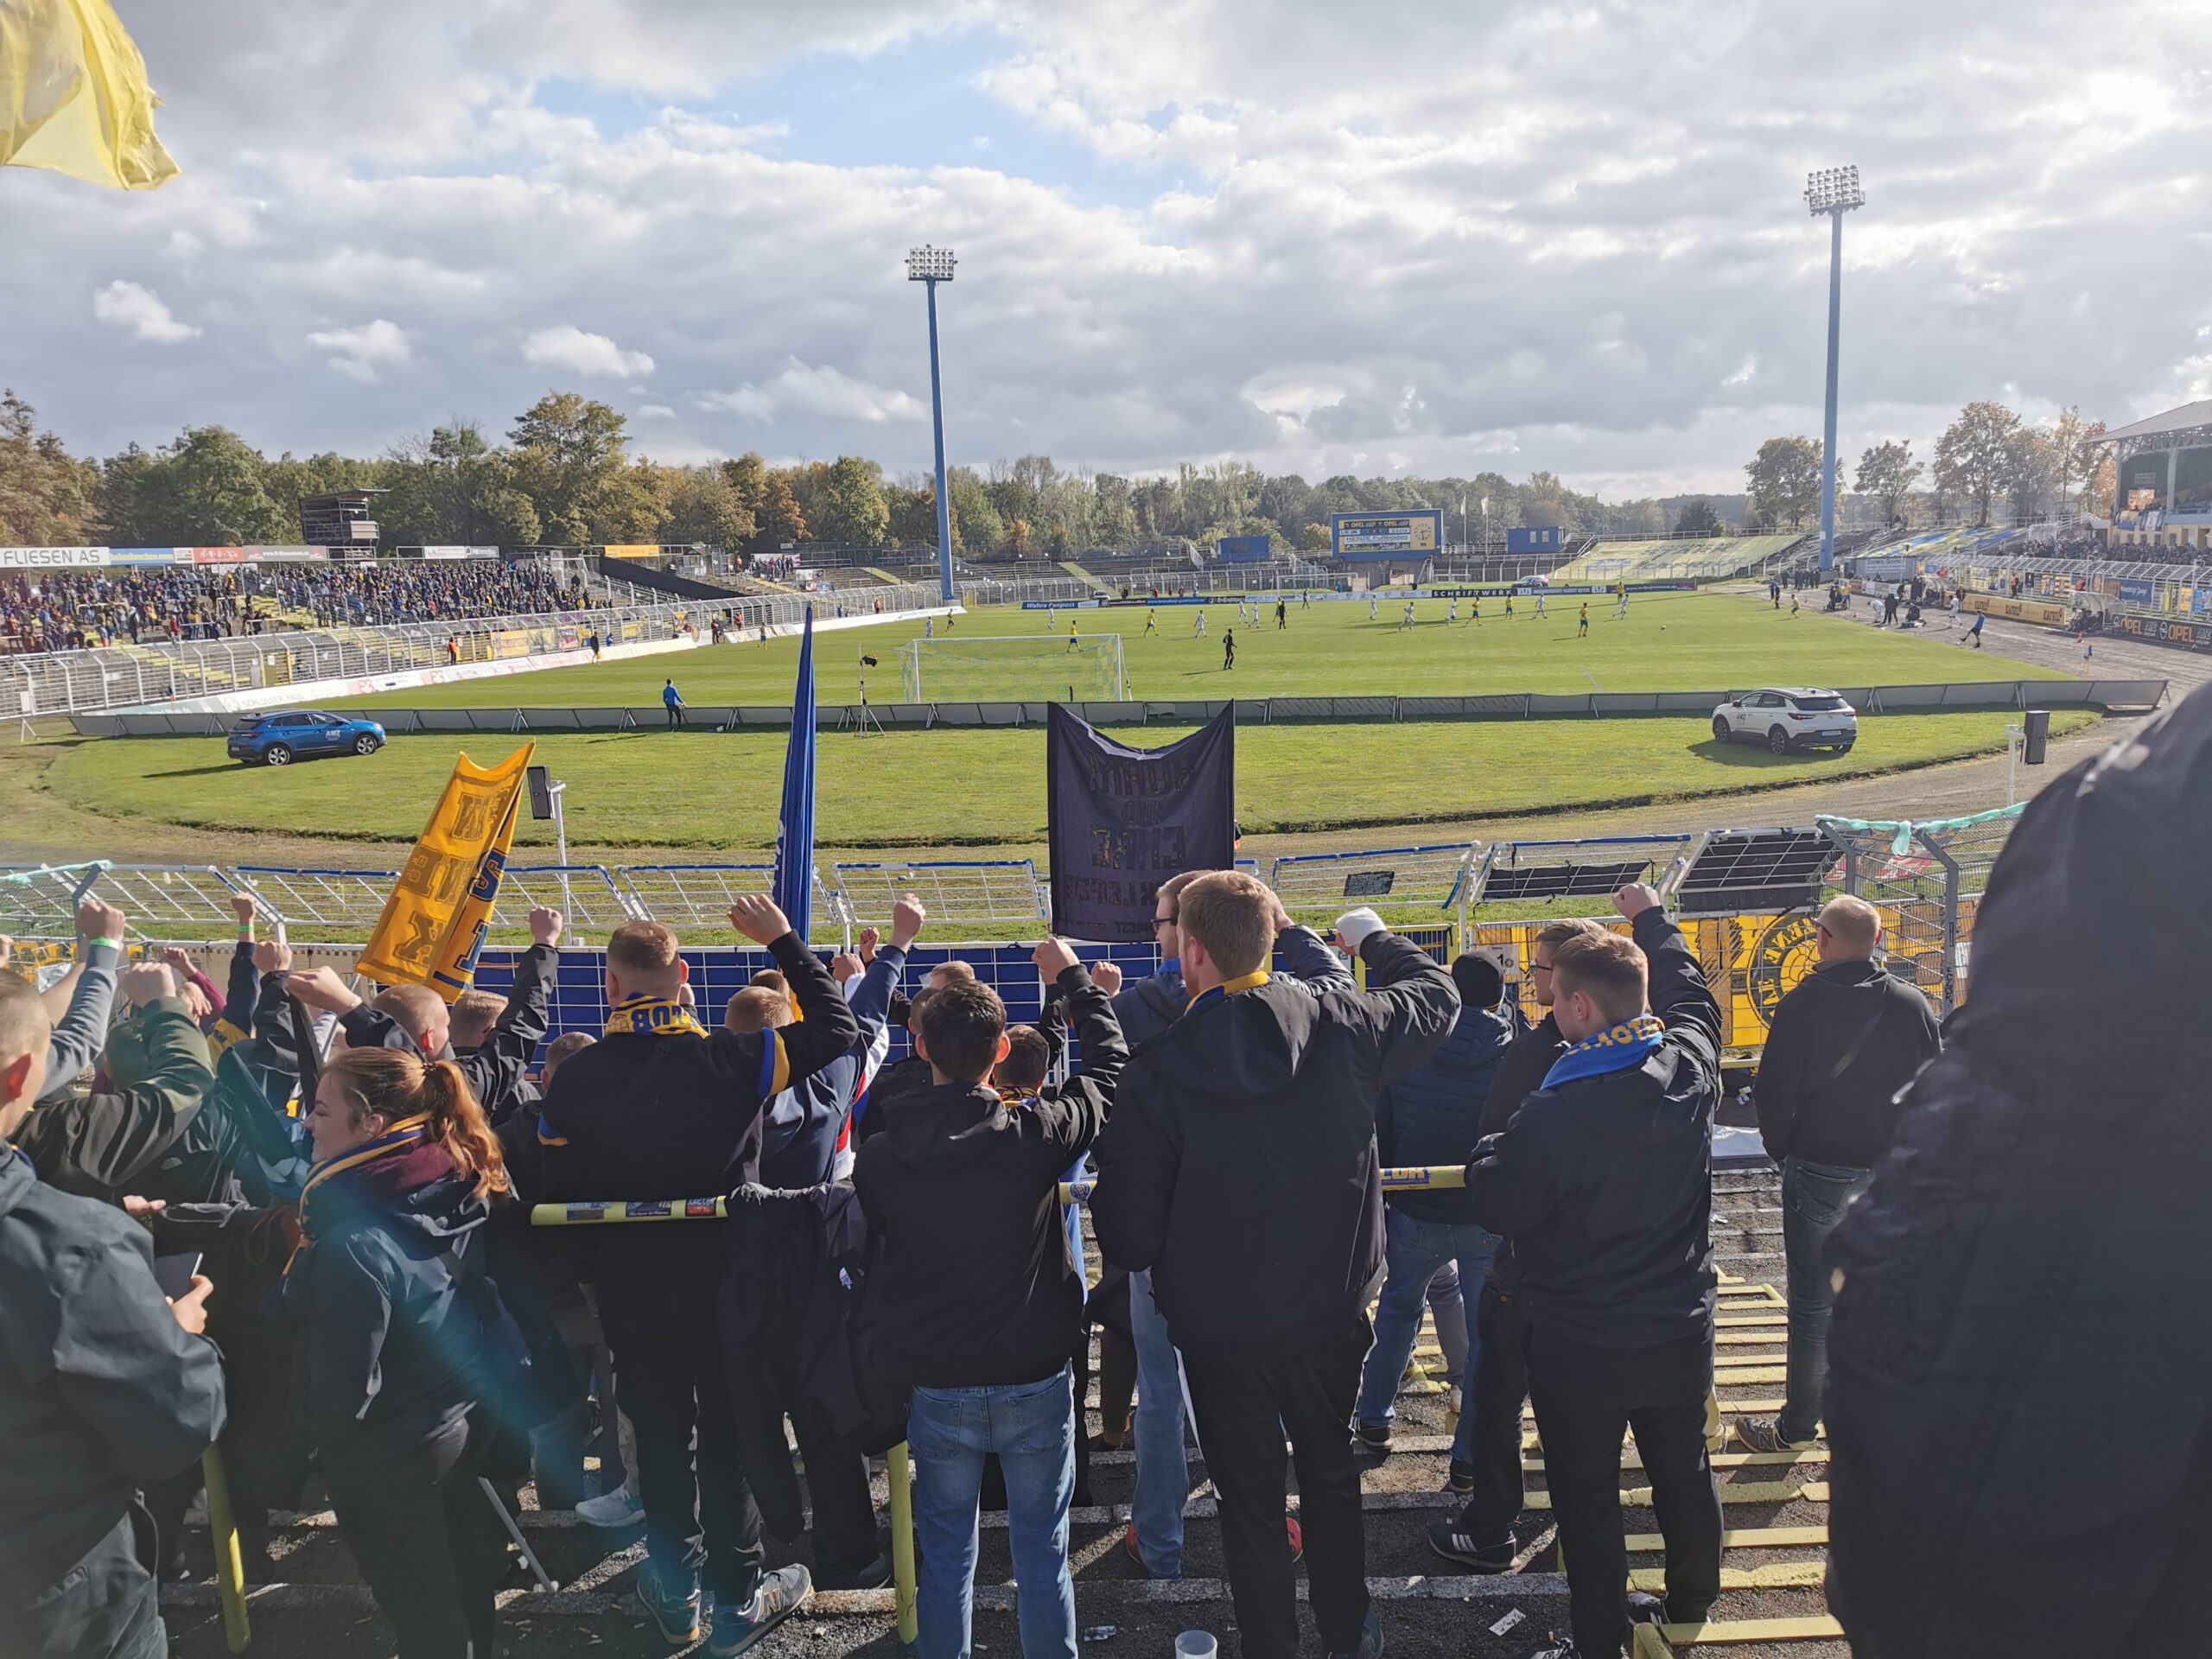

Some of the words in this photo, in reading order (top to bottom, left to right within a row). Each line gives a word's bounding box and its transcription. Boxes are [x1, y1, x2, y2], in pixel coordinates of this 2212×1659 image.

[4, 550, 73, 564] FLIESEN
[79, 550, 99, 563] AS
[2120, 617, 2144, 635] OPEL
[2168, 624, 2195, 643] OPEL
